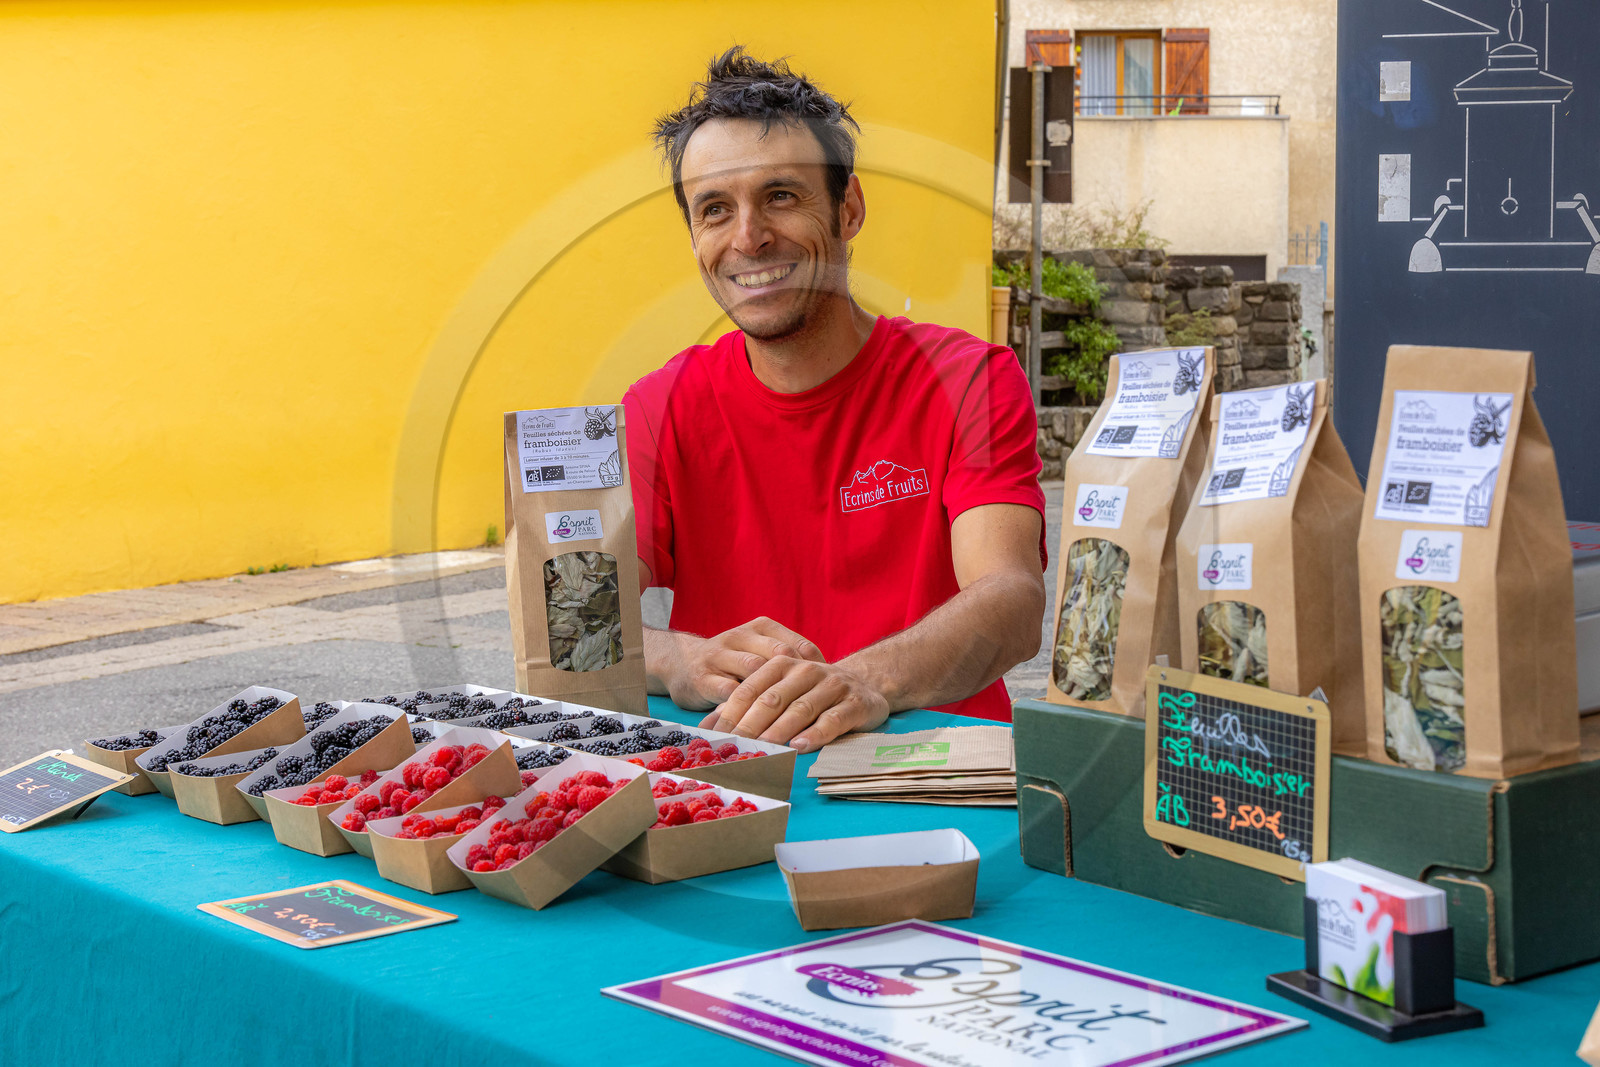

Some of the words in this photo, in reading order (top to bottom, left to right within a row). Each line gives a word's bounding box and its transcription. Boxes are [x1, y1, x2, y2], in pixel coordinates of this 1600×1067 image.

[1118, 391, 1168, 404] framboisier
[524, 437, 581, 448] framboisier
[1222, 430, 1276, 445] framboisier
[1396, 435, 1463, 452] framboisier
[527, 470, 541, 482] AB
[844, 490, 875, 508] Ecrins
[875, 484, 885, 500] de
[886, 475, 924, 498] Fruits
[556, 514, 595, 539] Esprit
[1162, 736, 1311, 798] Framboisier
[1155, 792, 1190, 827] AB
[1211, 795, 1285, 840] 3,50€
[810, 965, 884, 991] Ecrins
[916, 1013, 1053, 1061] NATIONAL
[943, 1004, 1095, 1051] PARC
